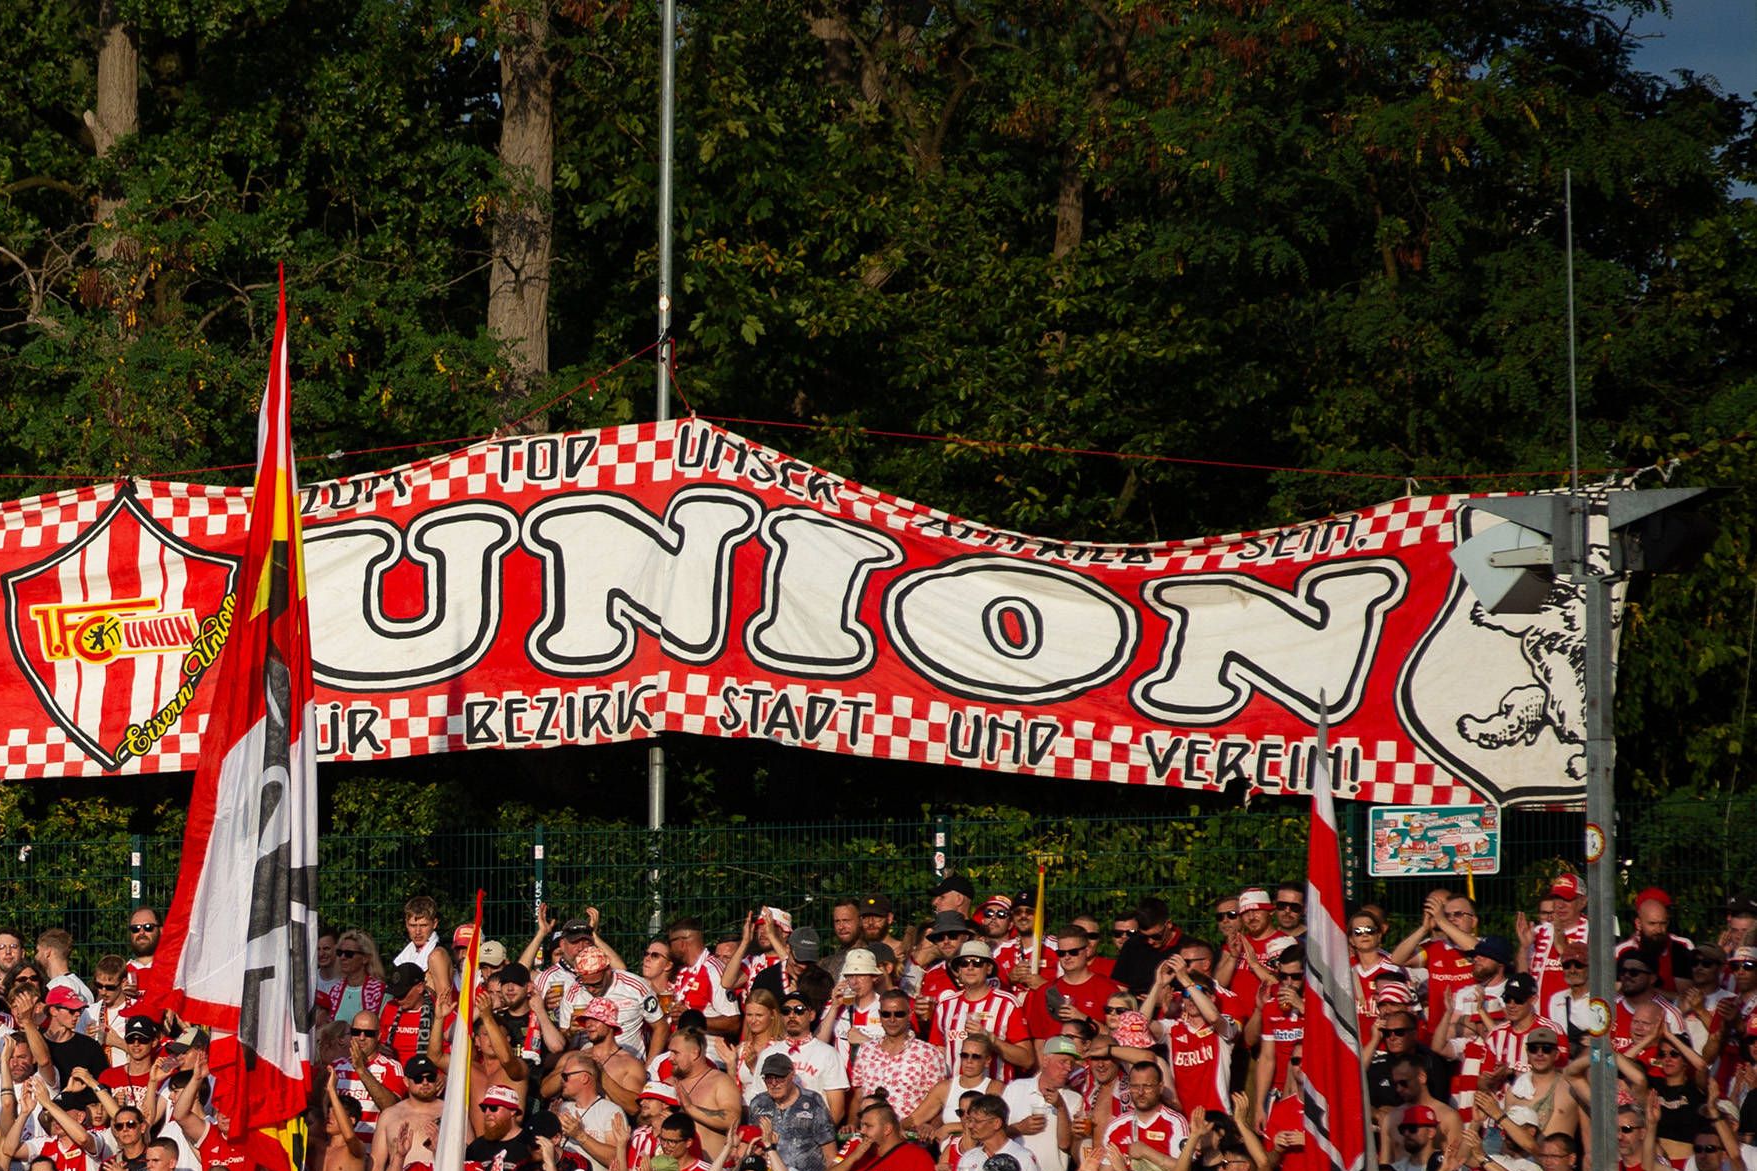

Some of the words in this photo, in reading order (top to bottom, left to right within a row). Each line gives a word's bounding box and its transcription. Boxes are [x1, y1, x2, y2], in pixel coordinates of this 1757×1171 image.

[299, 470, 409, 516] ZUM
[497, 435, 598, 485] TOD
[676, 421, 843, 507] UNSER
[124, 615, 195, 649] UNION
[302, 484, 1411, 728] UNION
[116, 681, 194, 763] Eisern
[313, 701, 385, 755] ÜR
[464, 684, 658, 746] BEZIRK
[718, 685, 875, 748] STADT
[948, 710, 1061, 768] UND
[1141, 731, 1364, 795] VEREIN!
[1174, 1046, 1213, 1067] BERLIN
